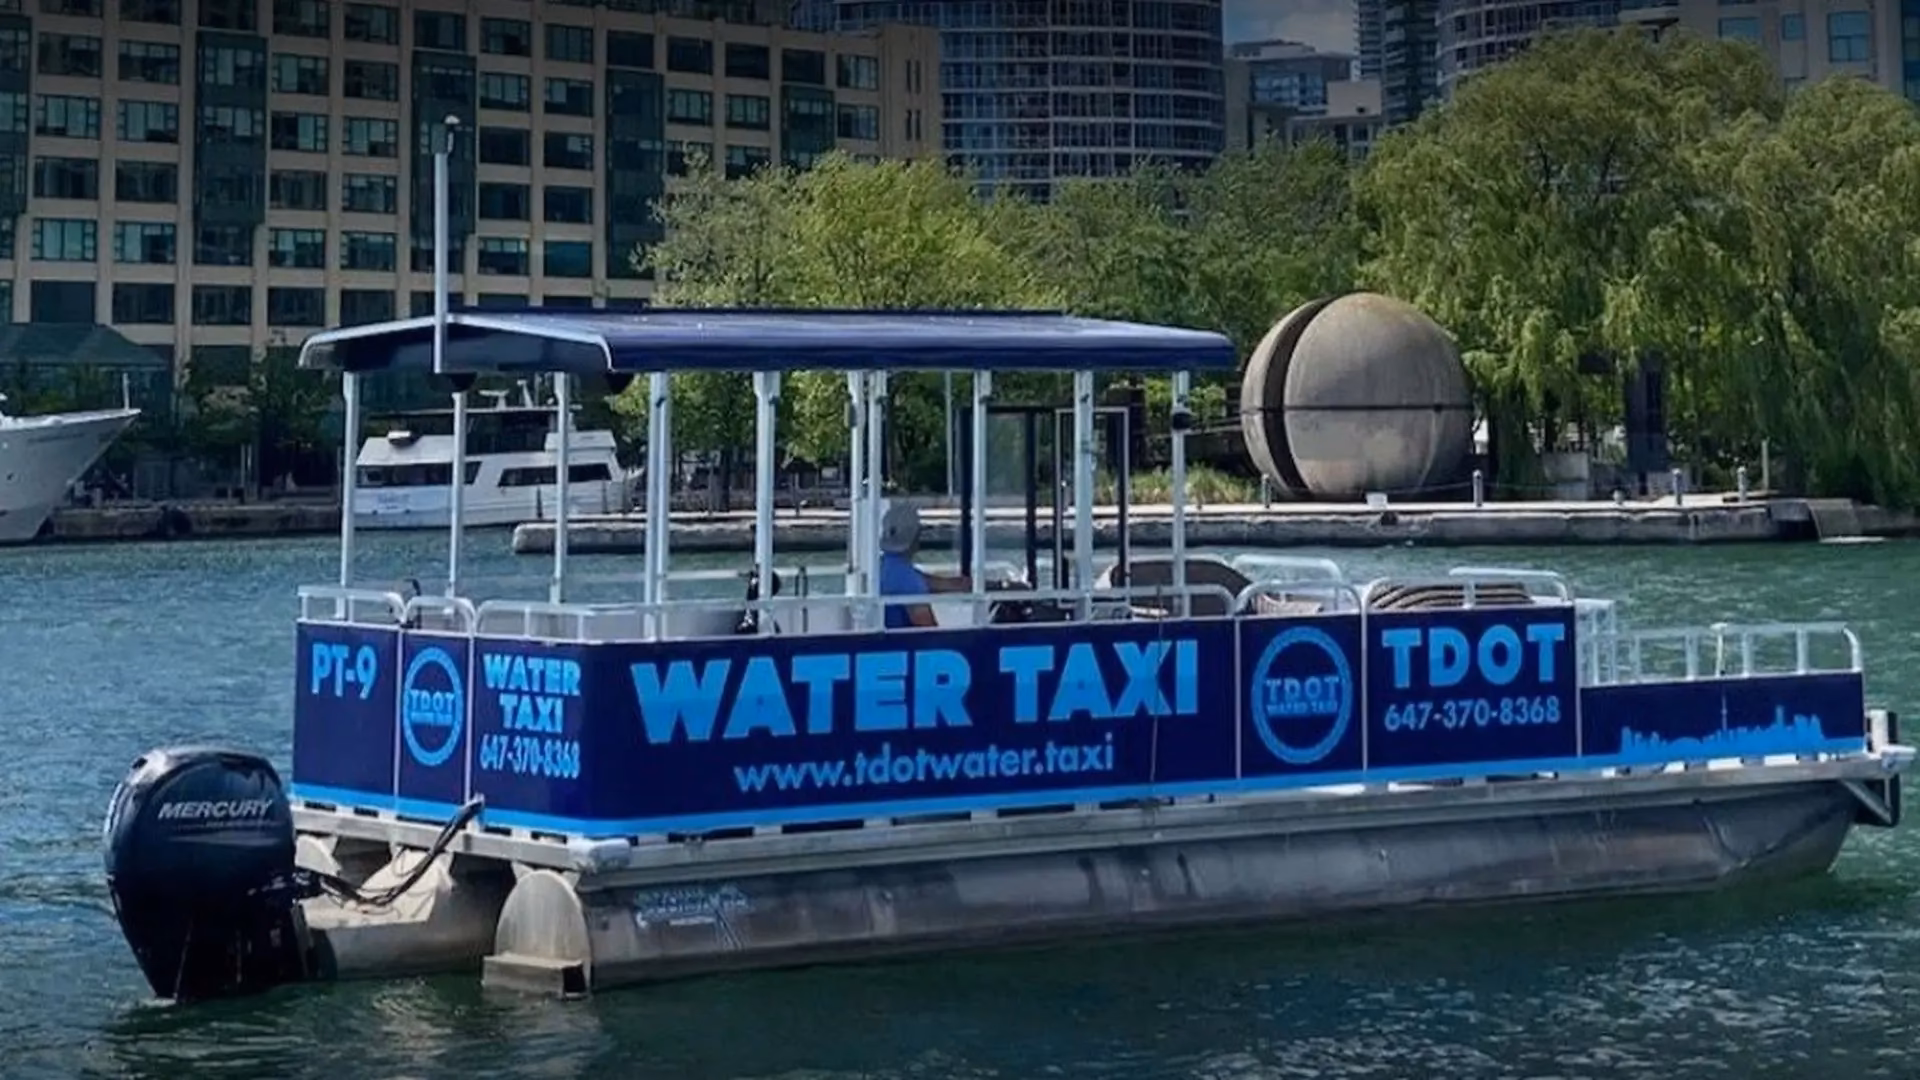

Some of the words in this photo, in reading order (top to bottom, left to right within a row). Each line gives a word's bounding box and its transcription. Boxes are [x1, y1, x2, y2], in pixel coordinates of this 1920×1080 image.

[311, 642, 377, 698] PT-9
[482, 653, 580, 695] WATER
[1381, 622, 1566, 688] TDOT
[409, 689, 455, 712] TDOT
[630, 649, 972, 744] WATER
[1000, 639, 1198, 722] TAXI
[1264, 676, 1340, 704] TDOT
[499, 694, 564, 733] TAXI
[1384, 696, 1561, 732] 647-370-8368
[479, 734, 581, 779] 647-370-8368
[734, 733, 1114, 792] www.tdotwater.taxi
[158, 800, 272, 819] MERCURY
